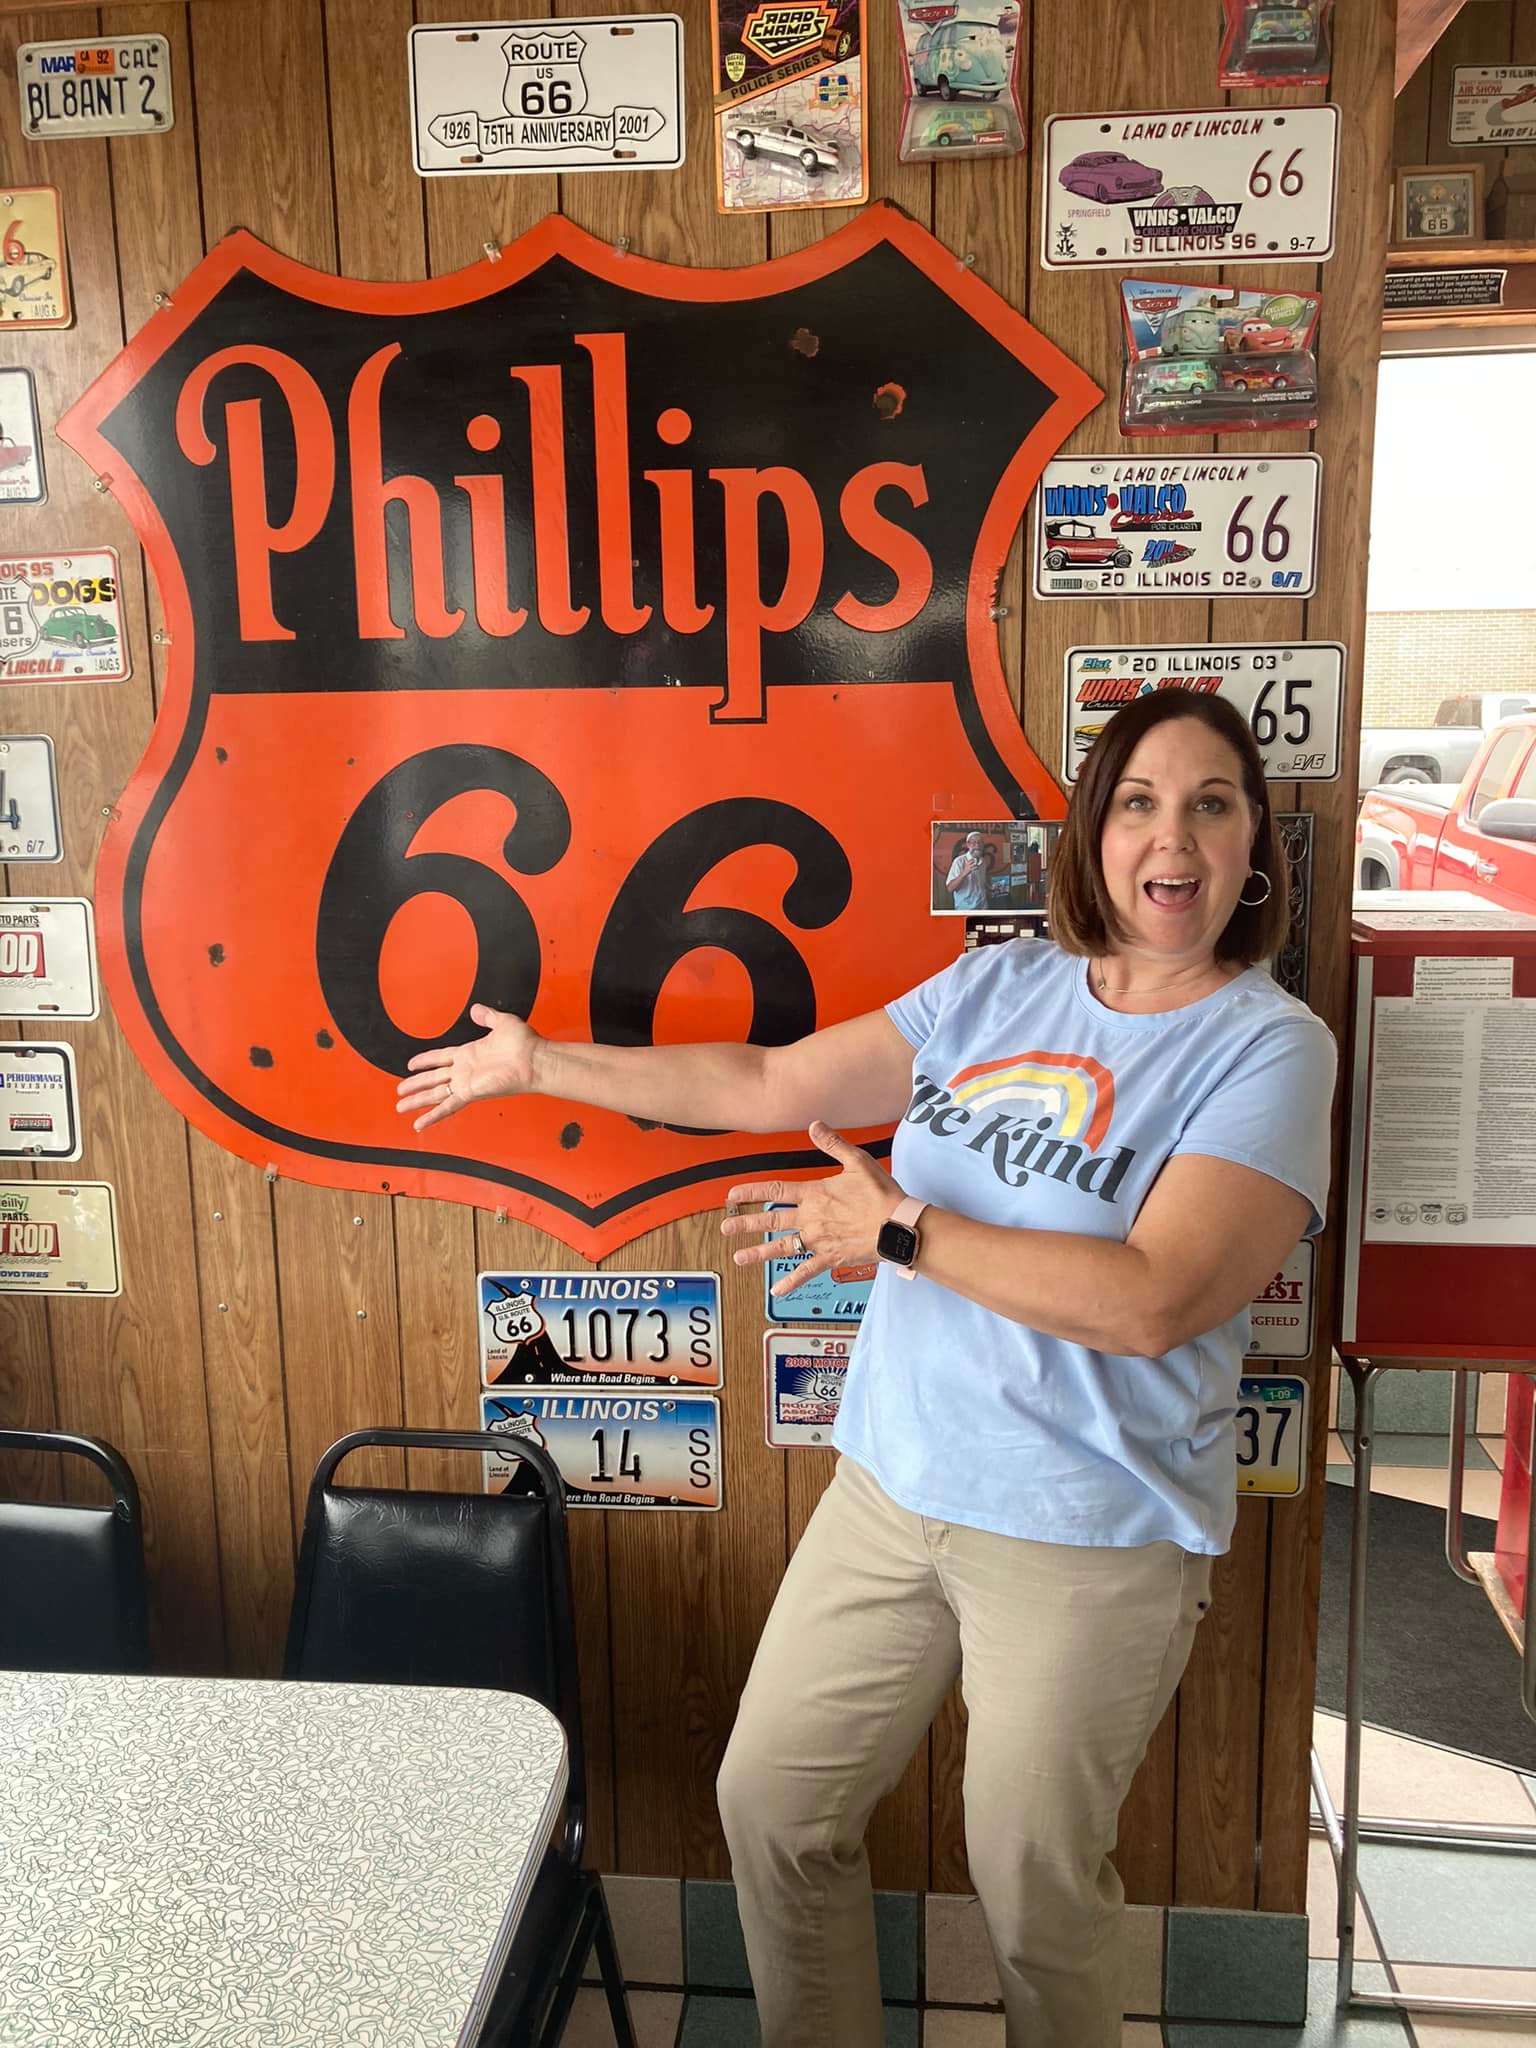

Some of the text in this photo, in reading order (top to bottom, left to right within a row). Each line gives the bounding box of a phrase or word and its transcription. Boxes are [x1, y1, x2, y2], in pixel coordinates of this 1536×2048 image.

[765, 11, 815, 24] ROAD
[751, 19, 825, 37] CHAMPS
[96, 50, 109, 64] 92
[119, 49, 157, 69] CAL
[511, 42, 578, 61] ROUTE
[41, 56, 76, 73] MAR
[536, 68, 553, 79] US
[730, 54, 820, 98] POLICE SERIES
[521, 80, 572, 115] 66
[1458, 85, 1503, 94] AIR SHOW
[27, 75, 157, 121] BL8ANT 2
[442, 121, 470, 140] 1926
[483, 119, 611, 145] 75TH ANNIVERSARY
[619, 115, 649, 134] 2001
[1122, 118, 1264, 141] LAND OF LINCOLN
[1489, 127, 1515, 138] LAND
[1248, 148, 1305, 198] 66
[1067, 208, 1111, 218] SPRINGFIELD
[1134, 206, 1235, 227] WNNS VALCO
[1142, 225, 1226, 236] CRUISE FOR CHARITY
[1428, 218, 1448, 230] 66
[3, 220, 25, 265] 6
[1124, 233, 1257, 254] 19 ILLINOIS 96
[1290, 237, 1316, 251] 9-7
[1134, 299, 1174, 310] Cars
[1113, 466, 1249, 482] LAND OF LINCOLN
[1045, 484, 1187, 516] WNNS VALCO
[1110, 510, 1195, 528] Cruise
[175, 331, 930, 724] Phillips
[1226, 495, 1290, 563] 66
[30, 562, 54, 577] 95
[1101, 571, 1246, 587] 20 ILLINOIS 02
[1271, 571, 1302, 588] 9/7
[32, 577, 117, 606] DOGS
[7, 659, 65, 675] LINCOLN
[1133, 656, 1276, 672] 20 ILLINOIS 03
[1252, 680, 1312, 746] 65
[1292, 753, 1326, 770] 9/6
[27, 840, 45, 853] 6/7
[0, 914, 40, 925] TO PARTS
[316, 743, 852, 1135] 66
[0, 934, 39, 974] OD
[7, 1073, 62, 1082] PERFORMANCE
[905, 1074, 1136, 1204] Be Kind
[1, 1197, 24, 1210] eilly
[3, 1213, 29, 1221] PARTS
[9, 1223, 54, 1254] ROD
[0, 1270, 20, 1278] OYO
[540, 1279, 660, 1300] ILLINOIS
[1256, 1281, 1303, 1299] EST
[495, 1298, 526, 1312] ILLINOIS
[510, 1308, 530, 1317] ROUTE
[834, 1301, 868, 1314] LAN
[507, 1316, 532, 1337] 66
[1251, 1316, 1300, 1327] GFIELD
[562, 1307, 669, 1363] 1073
[823, 1342, 846, 1355] 20
[785, 1357, 811, 1368] 2003
[550, 1373, 656, 1385] Where the Road Begins
[820, 1385, 837, 1397] 66
[1269, 1389, 1291, 1400] 1-09
[541, 1400, 660, 1421] ILLINOIS
[497, 1418, 527, 1431] ILLINOIS
[512, 1426, 532, 1435] OUTE
[590, 1428, 642, 1482] 14
[566, 1493, 656, 1505] ere the Road Begins
